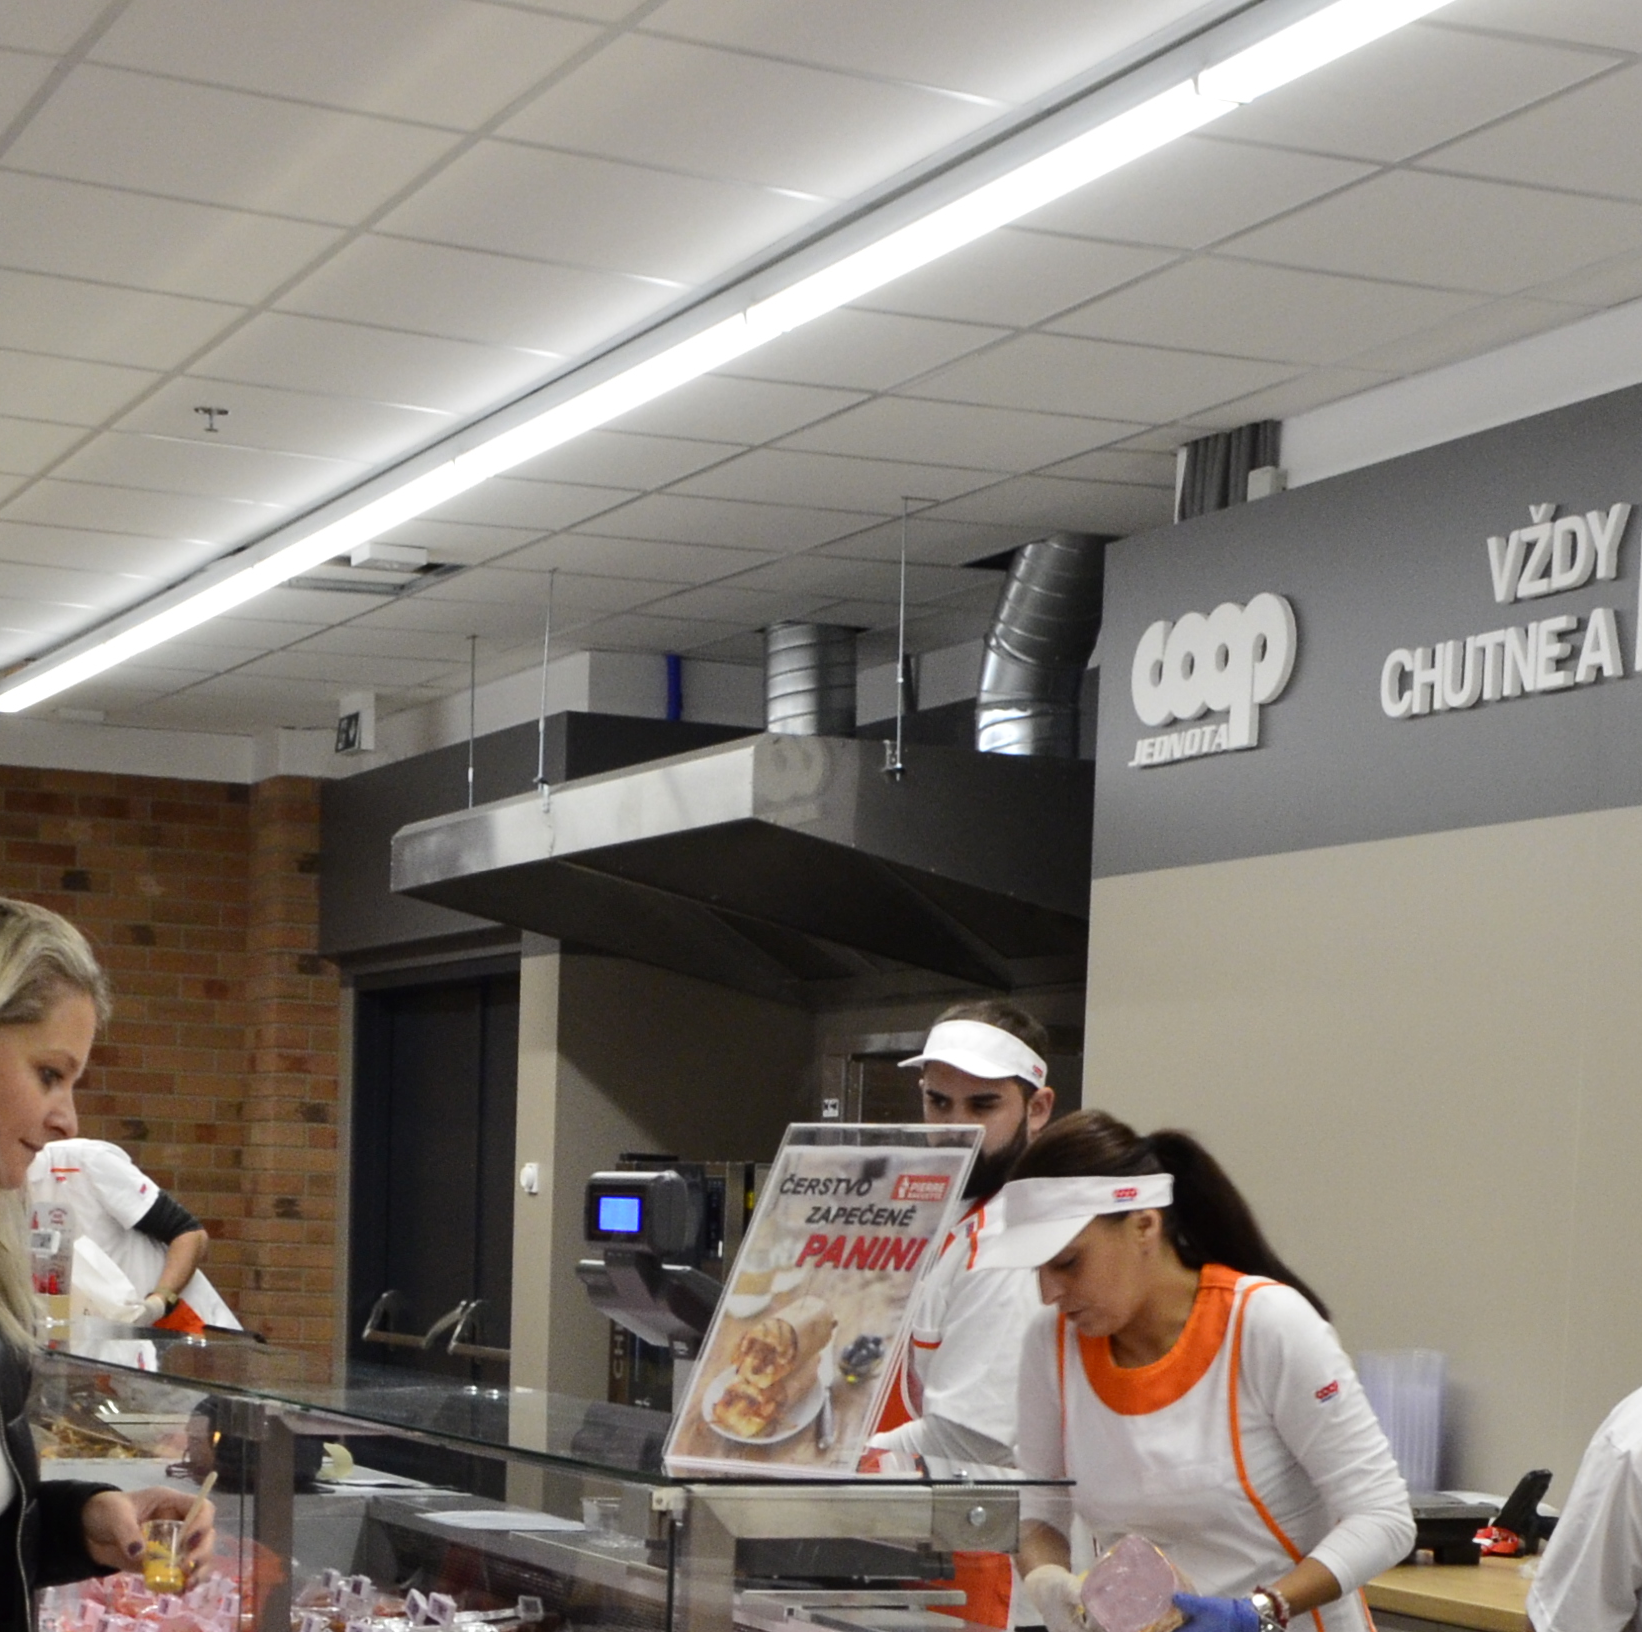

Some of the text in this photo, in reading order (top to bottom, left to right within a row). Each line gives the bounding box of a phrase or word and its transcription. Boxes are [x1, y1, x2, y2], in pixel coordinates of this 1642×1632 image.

[1487, 502, 1632, 603] VŽDY
[1131, 592, 1298, 748] coop
[1380, 607, 1624, 719] CHUTNE A
[1127, 722, 1229, 768] JEDNOTA
[779, 1173, 873, 1196] ČERSTVO
[806, 1204, 917, 1226] ZAPEČENÉ
[795, 1233, 928, 1271] PANINI
